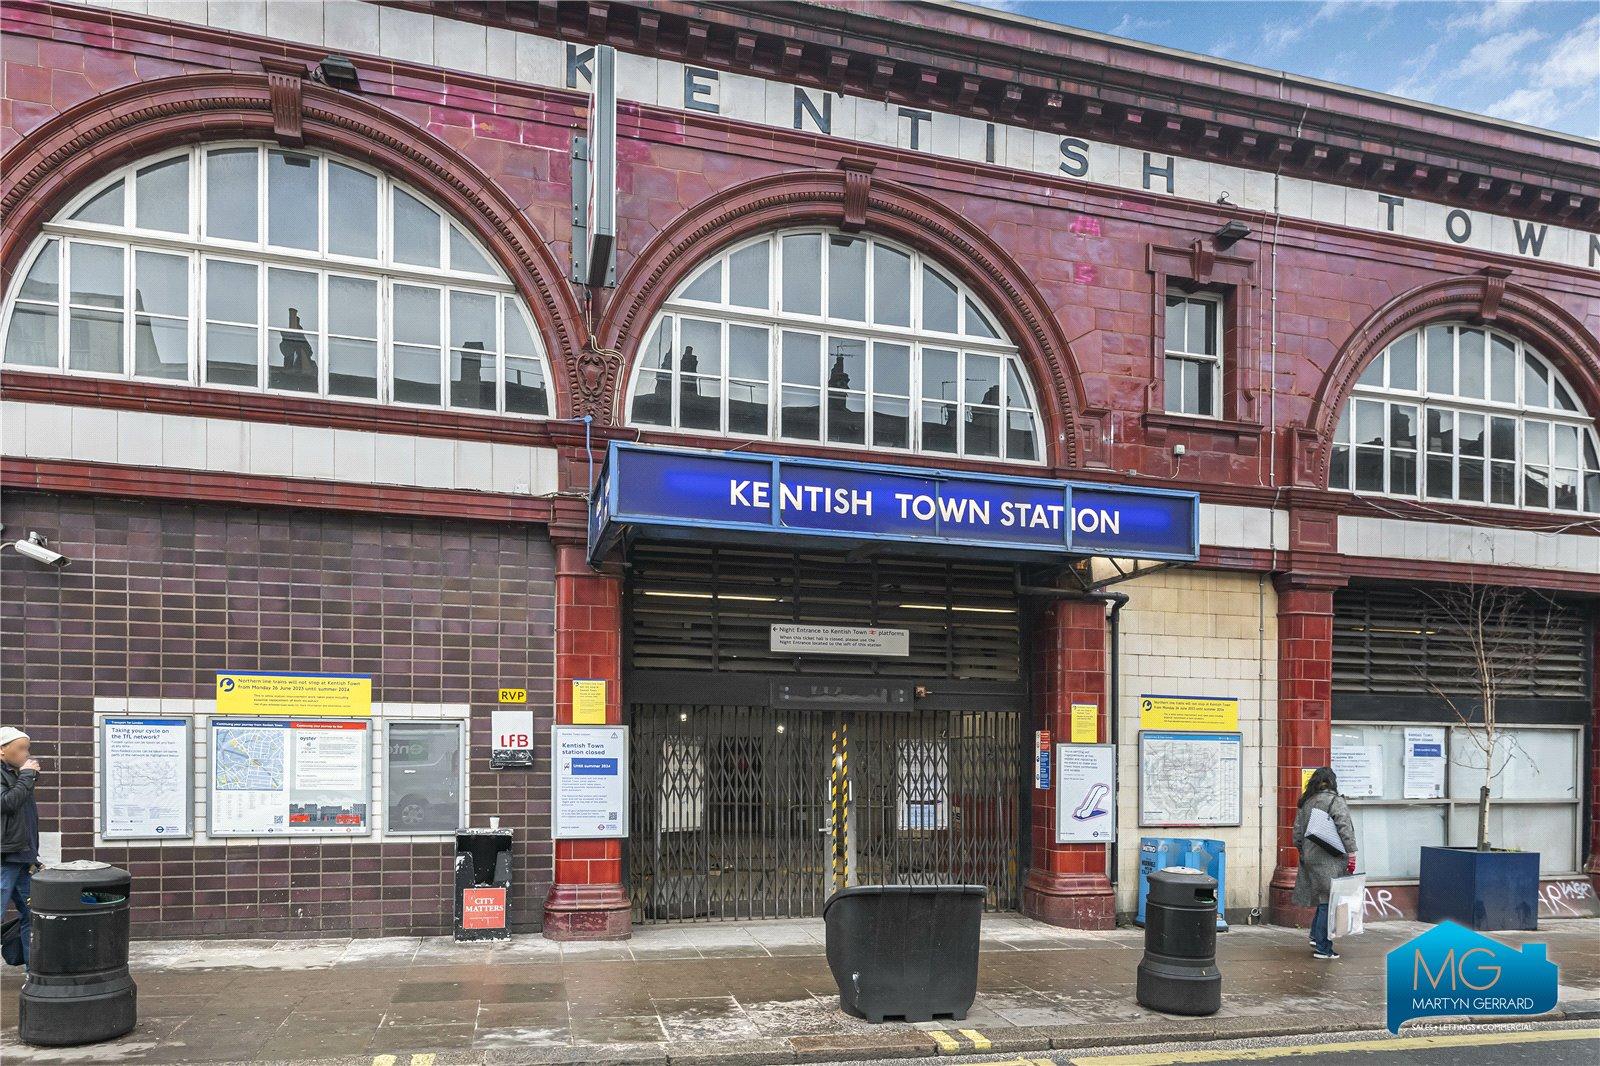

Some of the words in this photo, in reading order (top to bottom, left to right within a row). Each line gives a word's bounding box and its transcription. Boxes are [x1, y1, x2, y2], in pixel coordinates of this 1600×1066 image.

[566, 44, 1175, 194] KENTISH
[729, 480, 873, 515] KENTISH
[895, 493, 991, 525] TOWN
[1000, 502, 1121, 535] STATION
[501, 691, 525, 700] RVP
[500, 734, 529, 748] LFB
[465, 905, 504, 913] MATTERS
